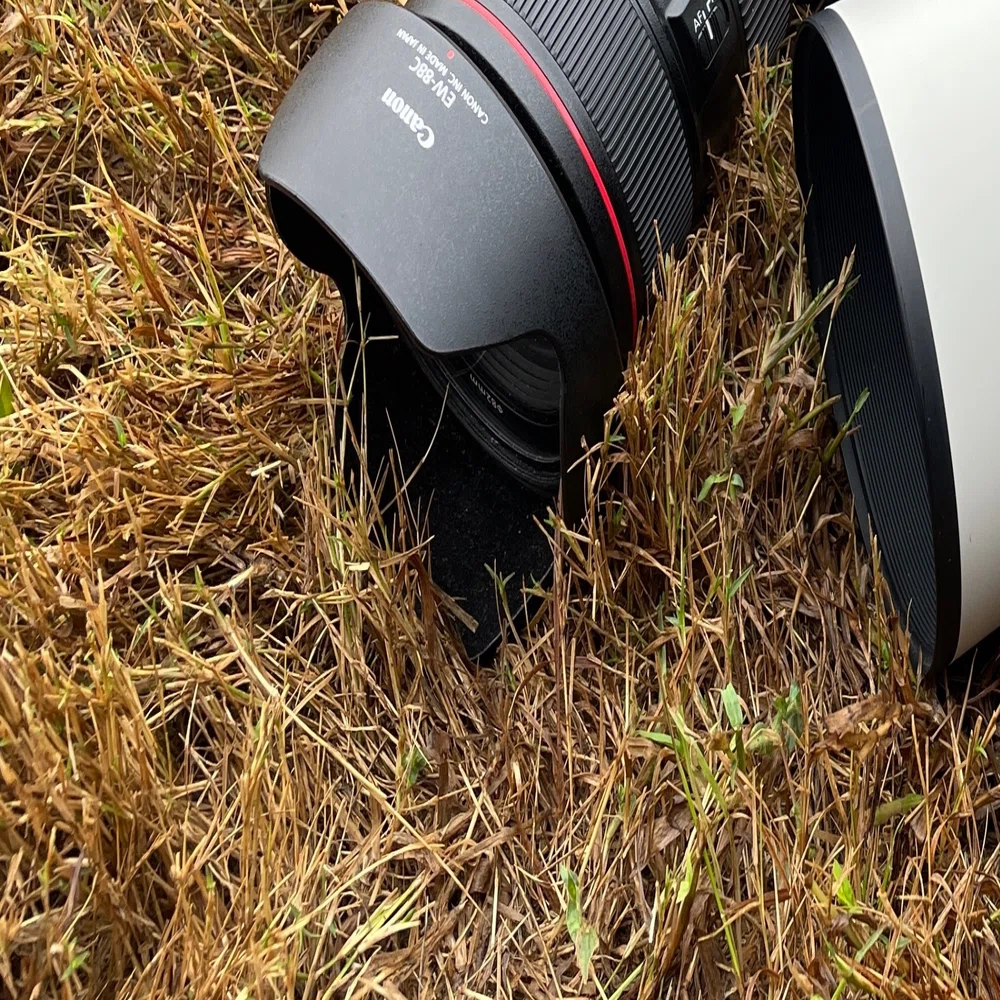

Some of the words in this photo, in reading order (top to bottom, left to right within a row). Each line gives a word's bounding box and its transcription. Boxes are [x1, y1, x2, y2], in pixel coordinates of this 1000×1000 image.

[693, 10, 703, 33] AF
[396, 28, 420, 49] JAPAN
[416, 43, 428, 56] IN
[424, 50, 449, 77] MADE
[408, 56, 457, 109] EW-88C
[381, 87, 435, 149] Canon
[460, 88, 489, 125] CANON
